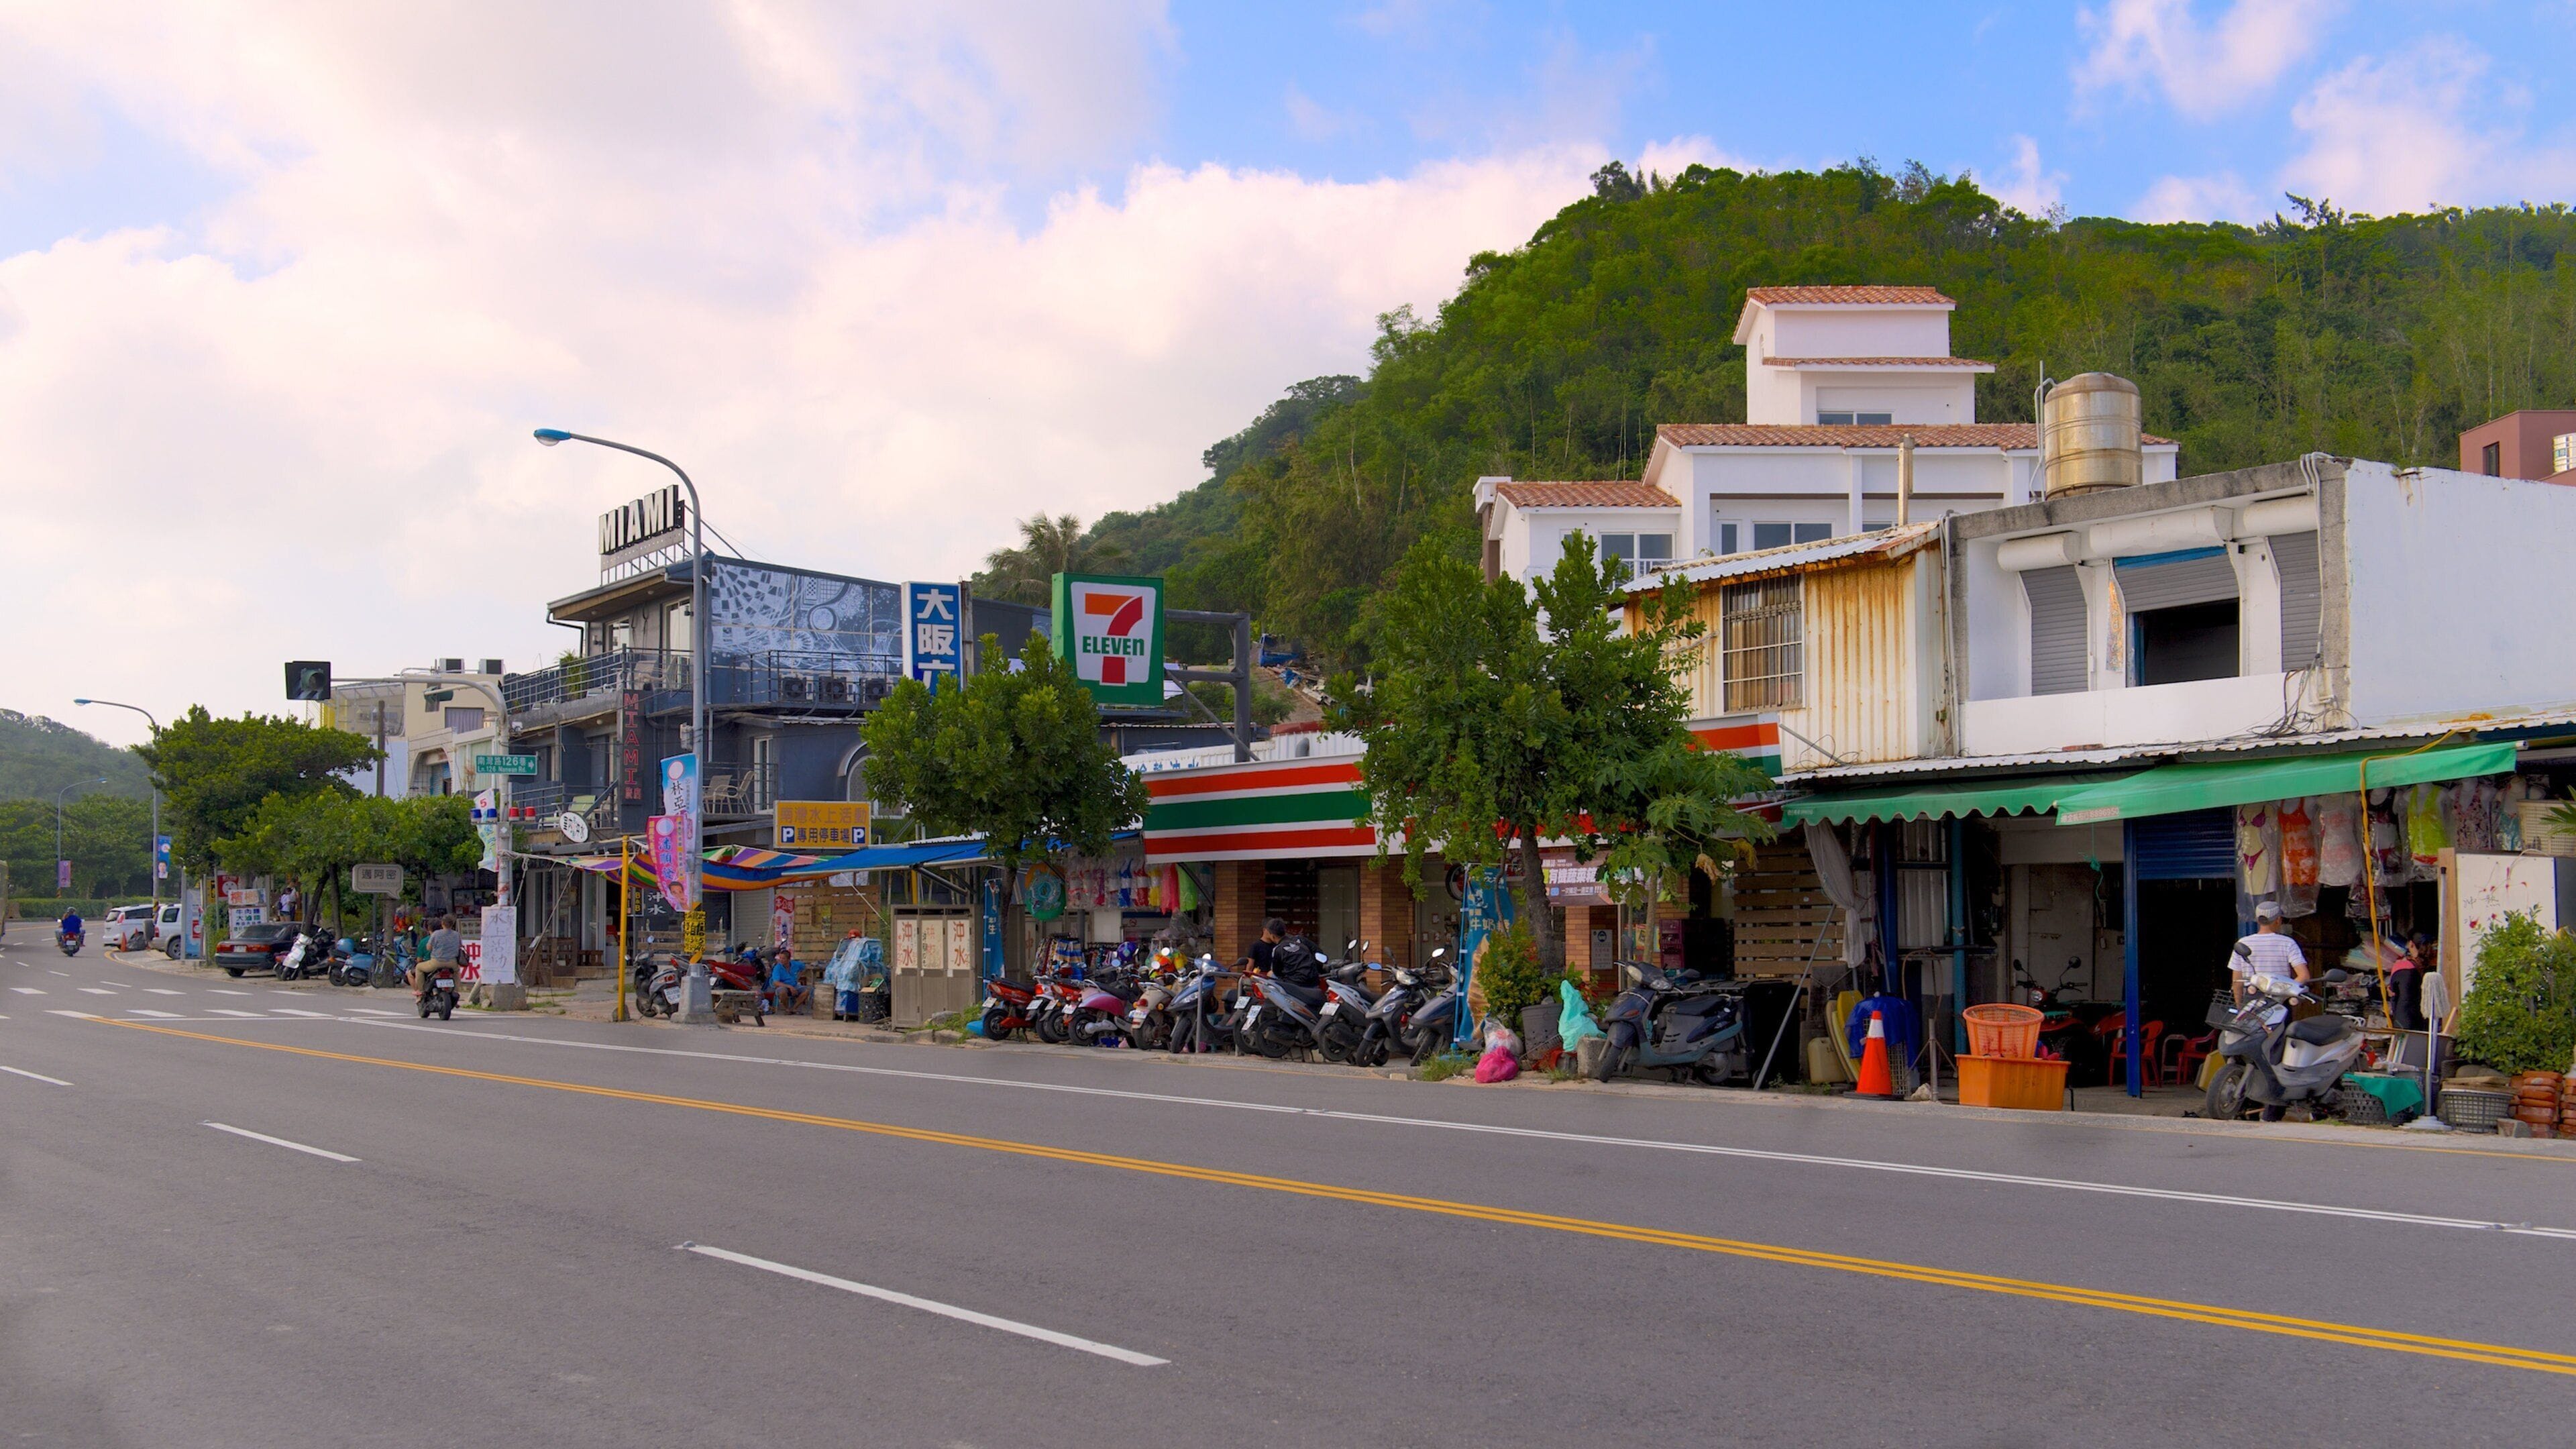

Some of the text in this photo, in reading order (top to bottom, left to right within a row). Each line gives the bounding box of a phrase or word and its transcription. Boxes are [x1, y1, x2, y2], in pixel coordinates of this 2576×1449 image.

[599, 484, 678, 555] MIAMI
[1085, 593, 1142, 684] 7
[624, 693, 639, 785] MIAMI
[480, 798, 487, 808] 5
[671, 780, 686, 816] 林亞
[781, 807, 867, 824] 南灣水上活動
[798, 828, 850, 843] 專用停車場
